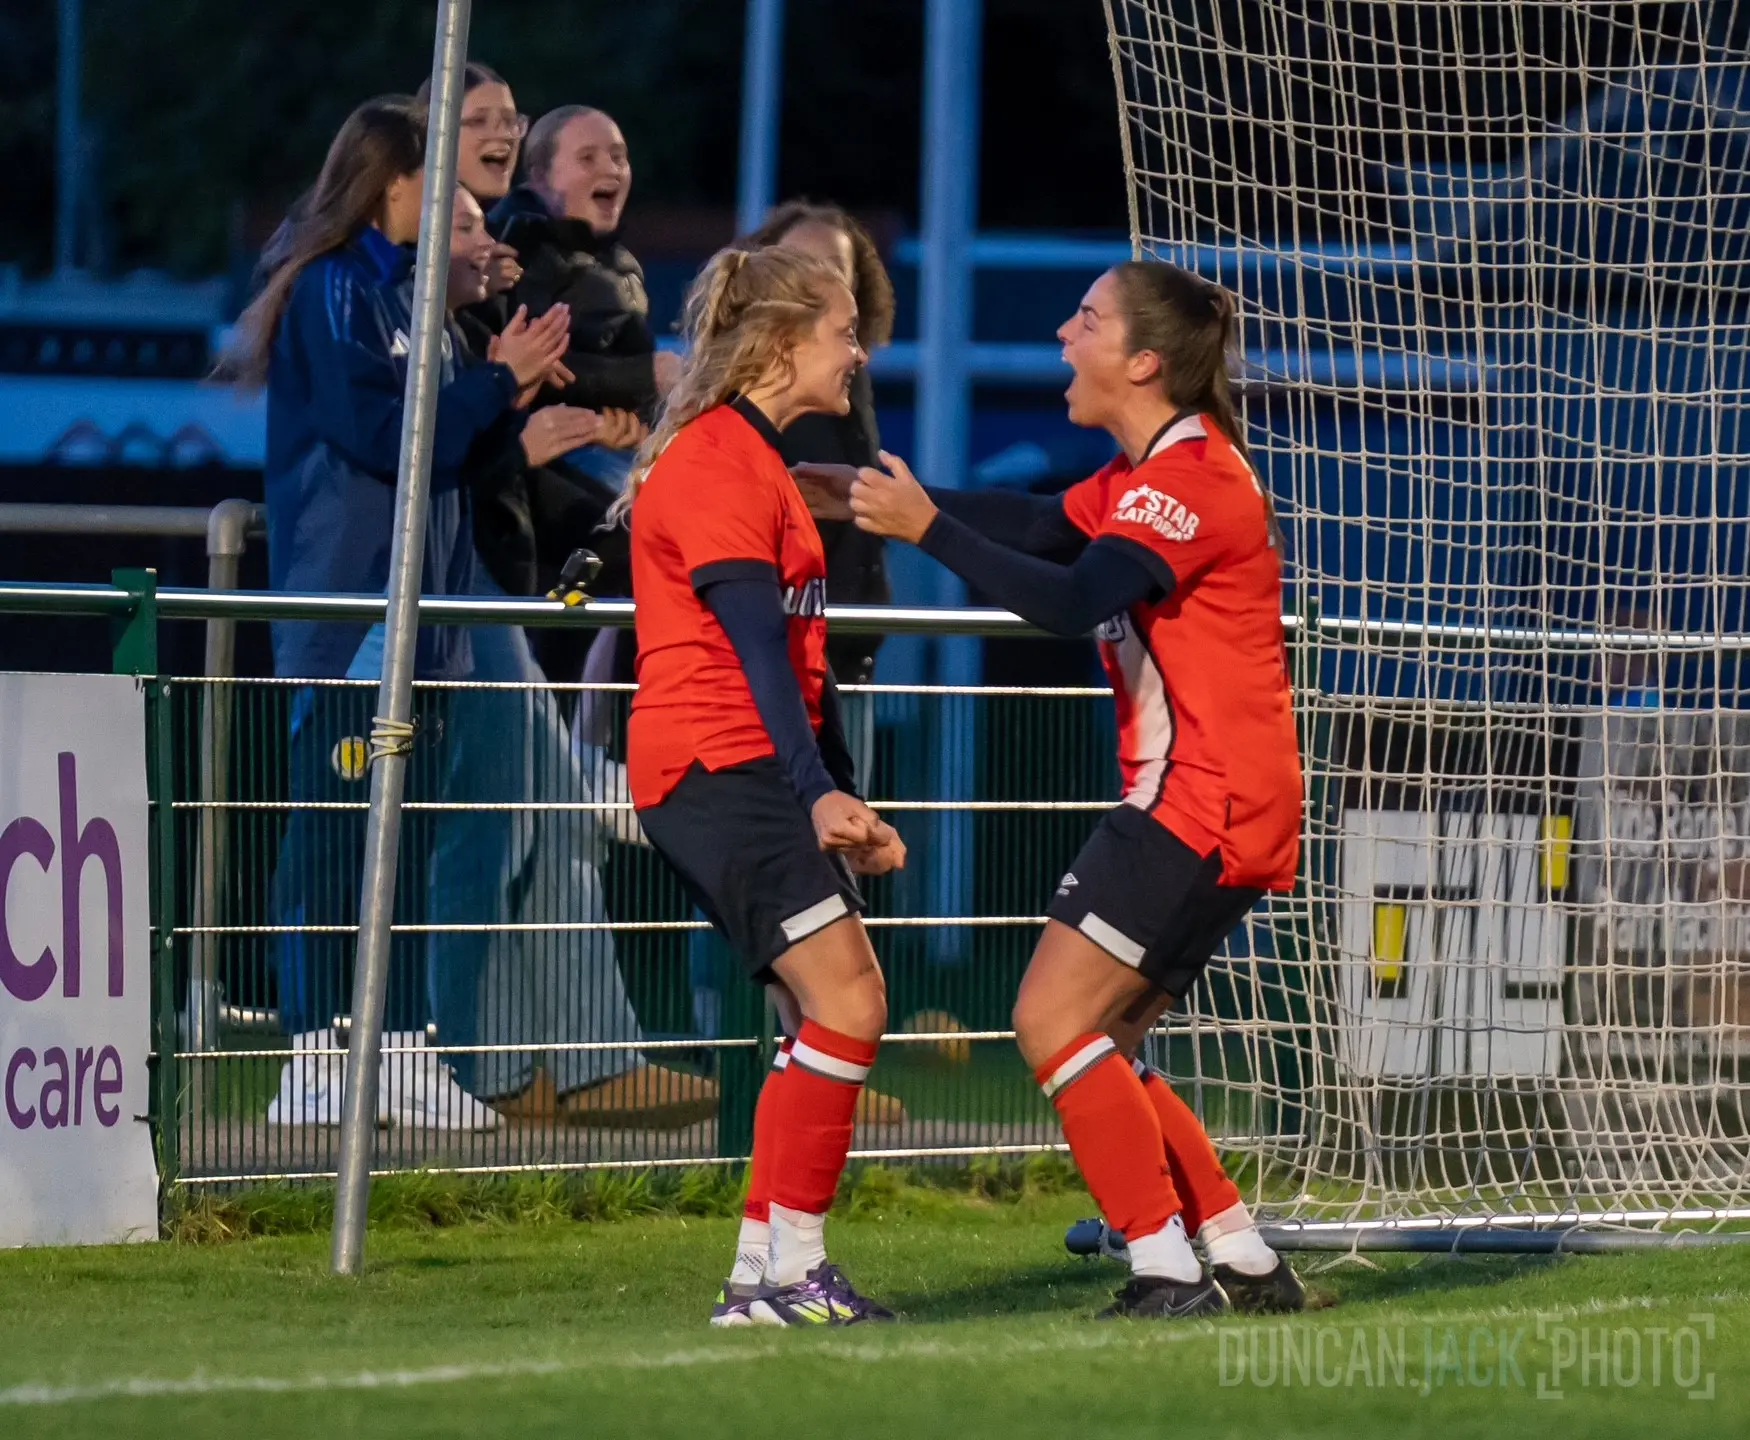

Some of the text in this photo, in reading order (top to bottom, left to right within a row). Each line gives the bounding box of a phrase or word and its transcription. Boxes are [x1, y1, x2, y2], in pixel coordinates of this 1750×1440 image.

[1145, 490, 1200, 536] STAR
[0, 751, 124, 1002] ch
[5, 1044, 123, 1130] care
